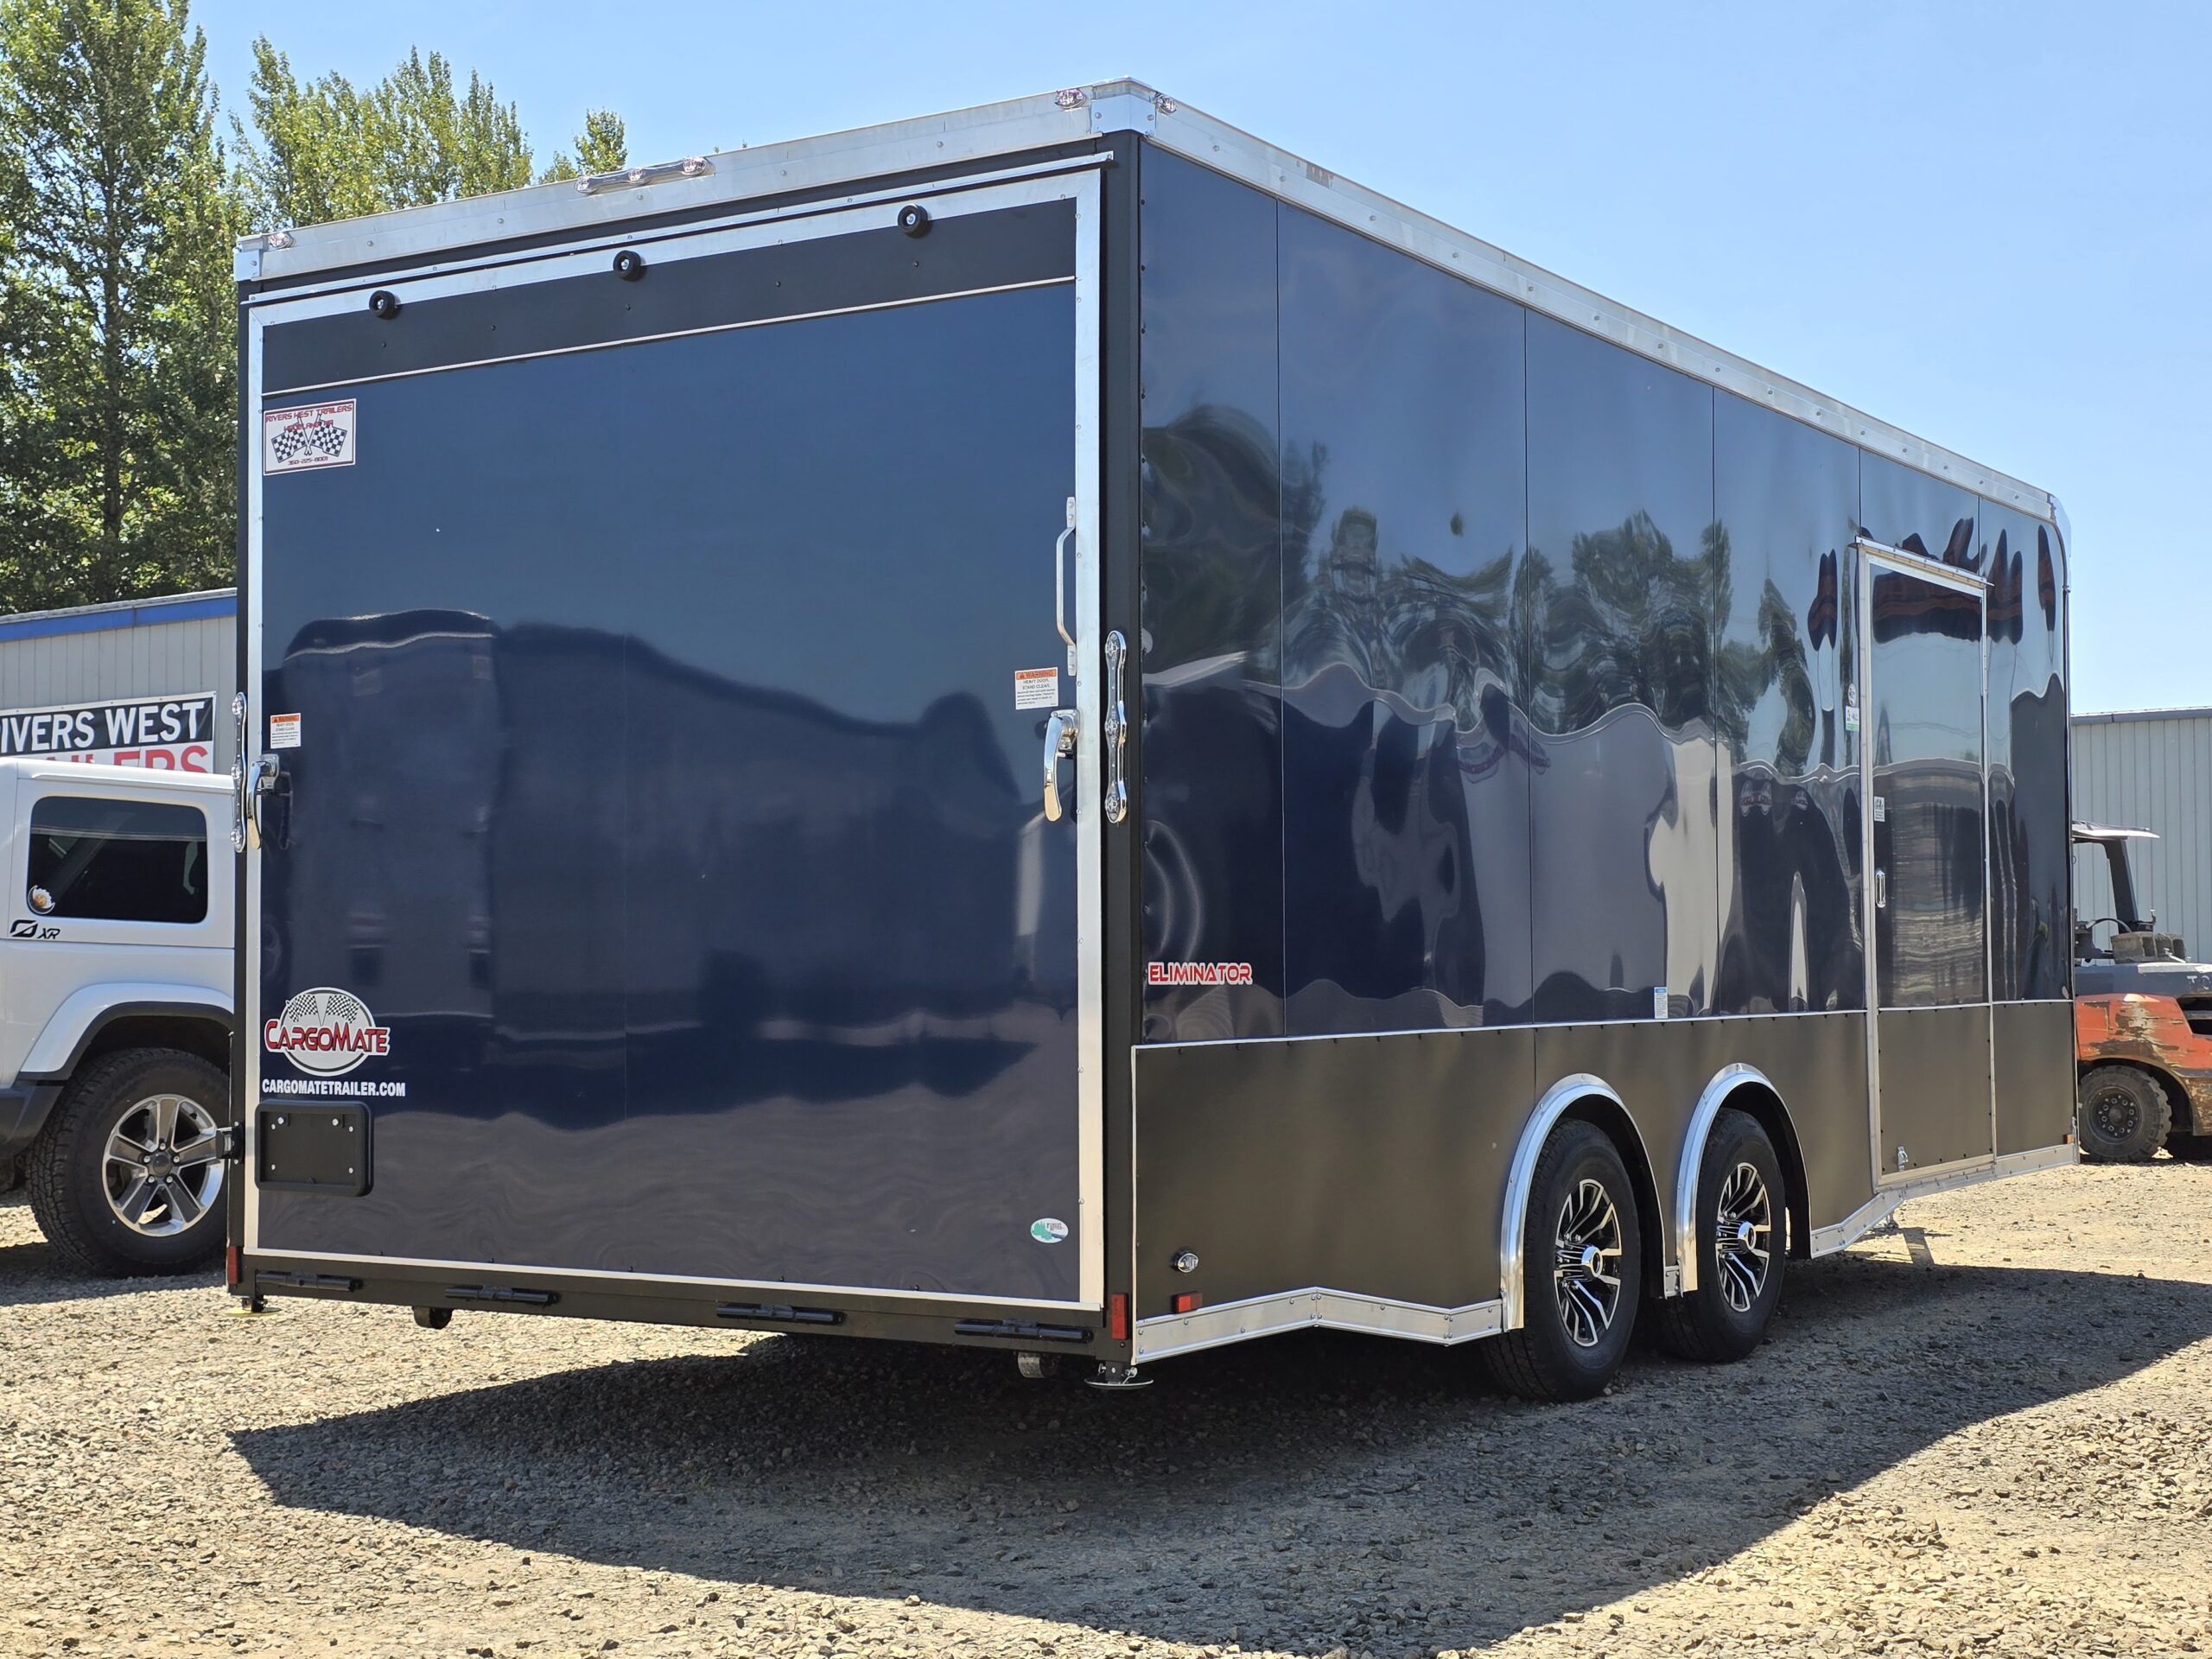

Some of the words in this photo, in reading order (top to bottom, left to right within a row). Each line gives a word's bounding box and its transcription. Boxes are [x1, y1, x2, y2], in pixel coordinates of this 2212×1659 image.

[316, 405, 352, 416] TRAILERS
[0, 711, 95, 753] IVERS
[105, 701, 205, 746] WEST
[1147, 962, 1253, 985] ELIMINATOR
[262, 1078, 405, 1096] CARGOMATETRAILER.COM
